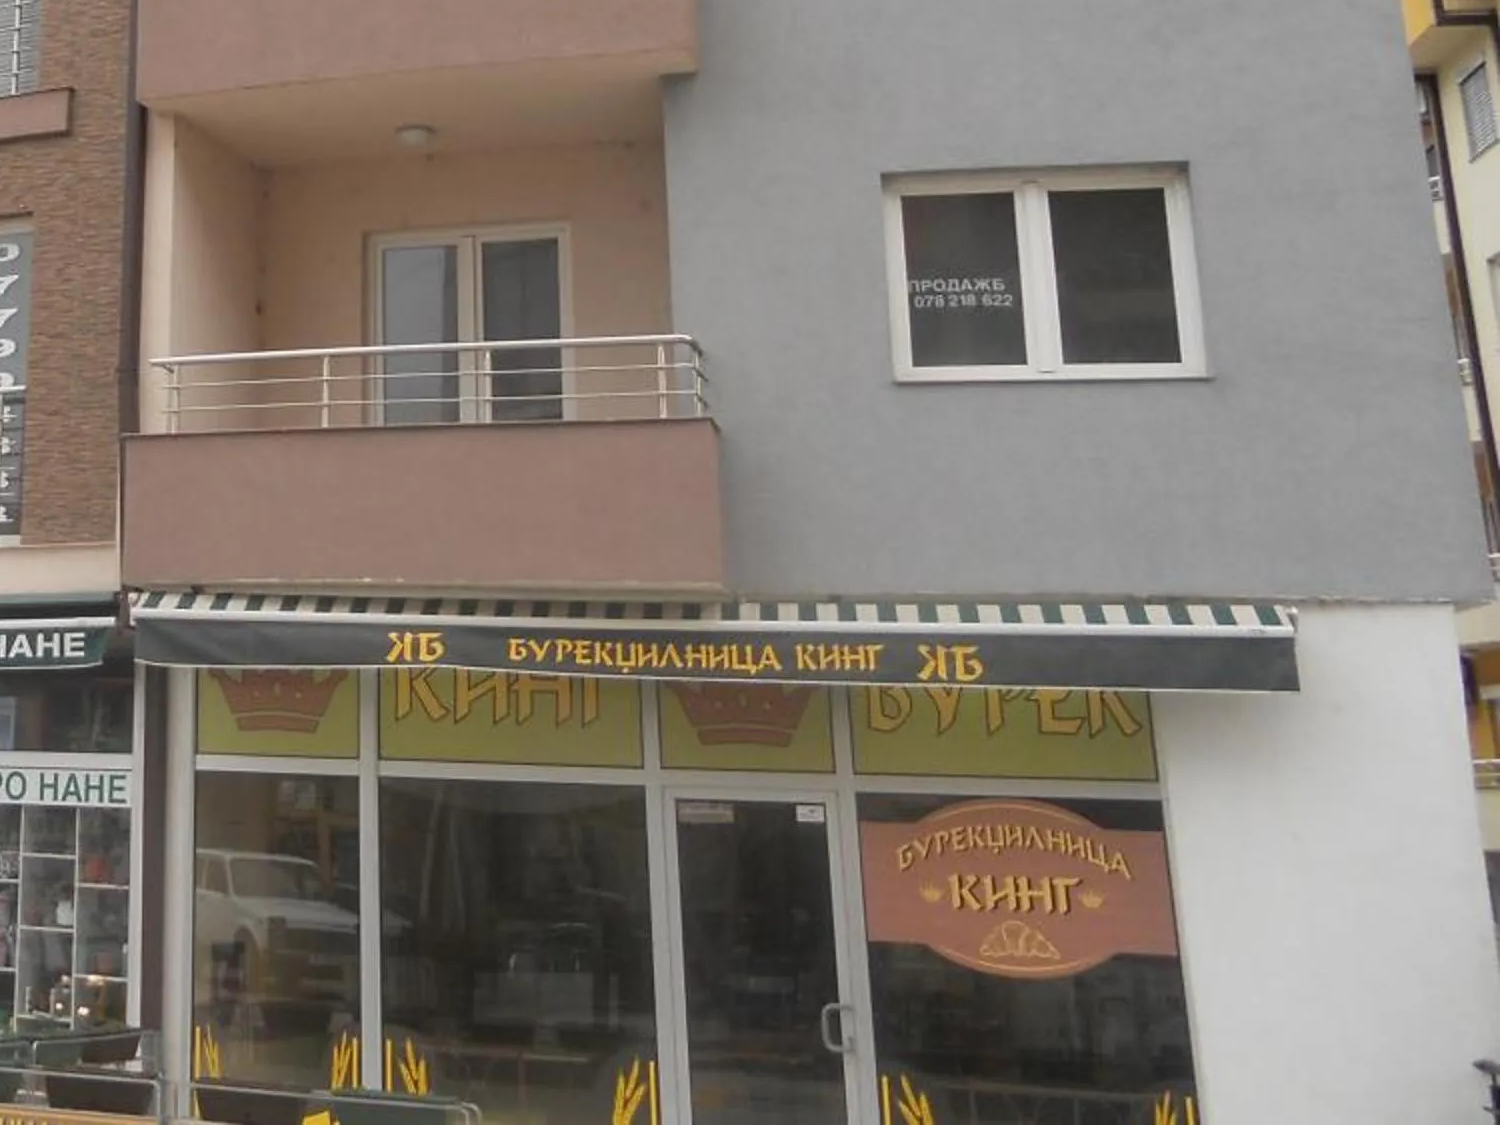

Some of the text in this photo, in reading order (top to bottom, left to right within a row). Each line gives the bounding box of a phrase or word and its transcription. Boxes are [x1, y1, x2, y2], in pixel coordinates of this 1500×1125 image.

[796, 644, 885, 672] КИНГ
[39, 771, 127, 804] НАНЕ
[948, 873, 1083, 914] КИНГ
